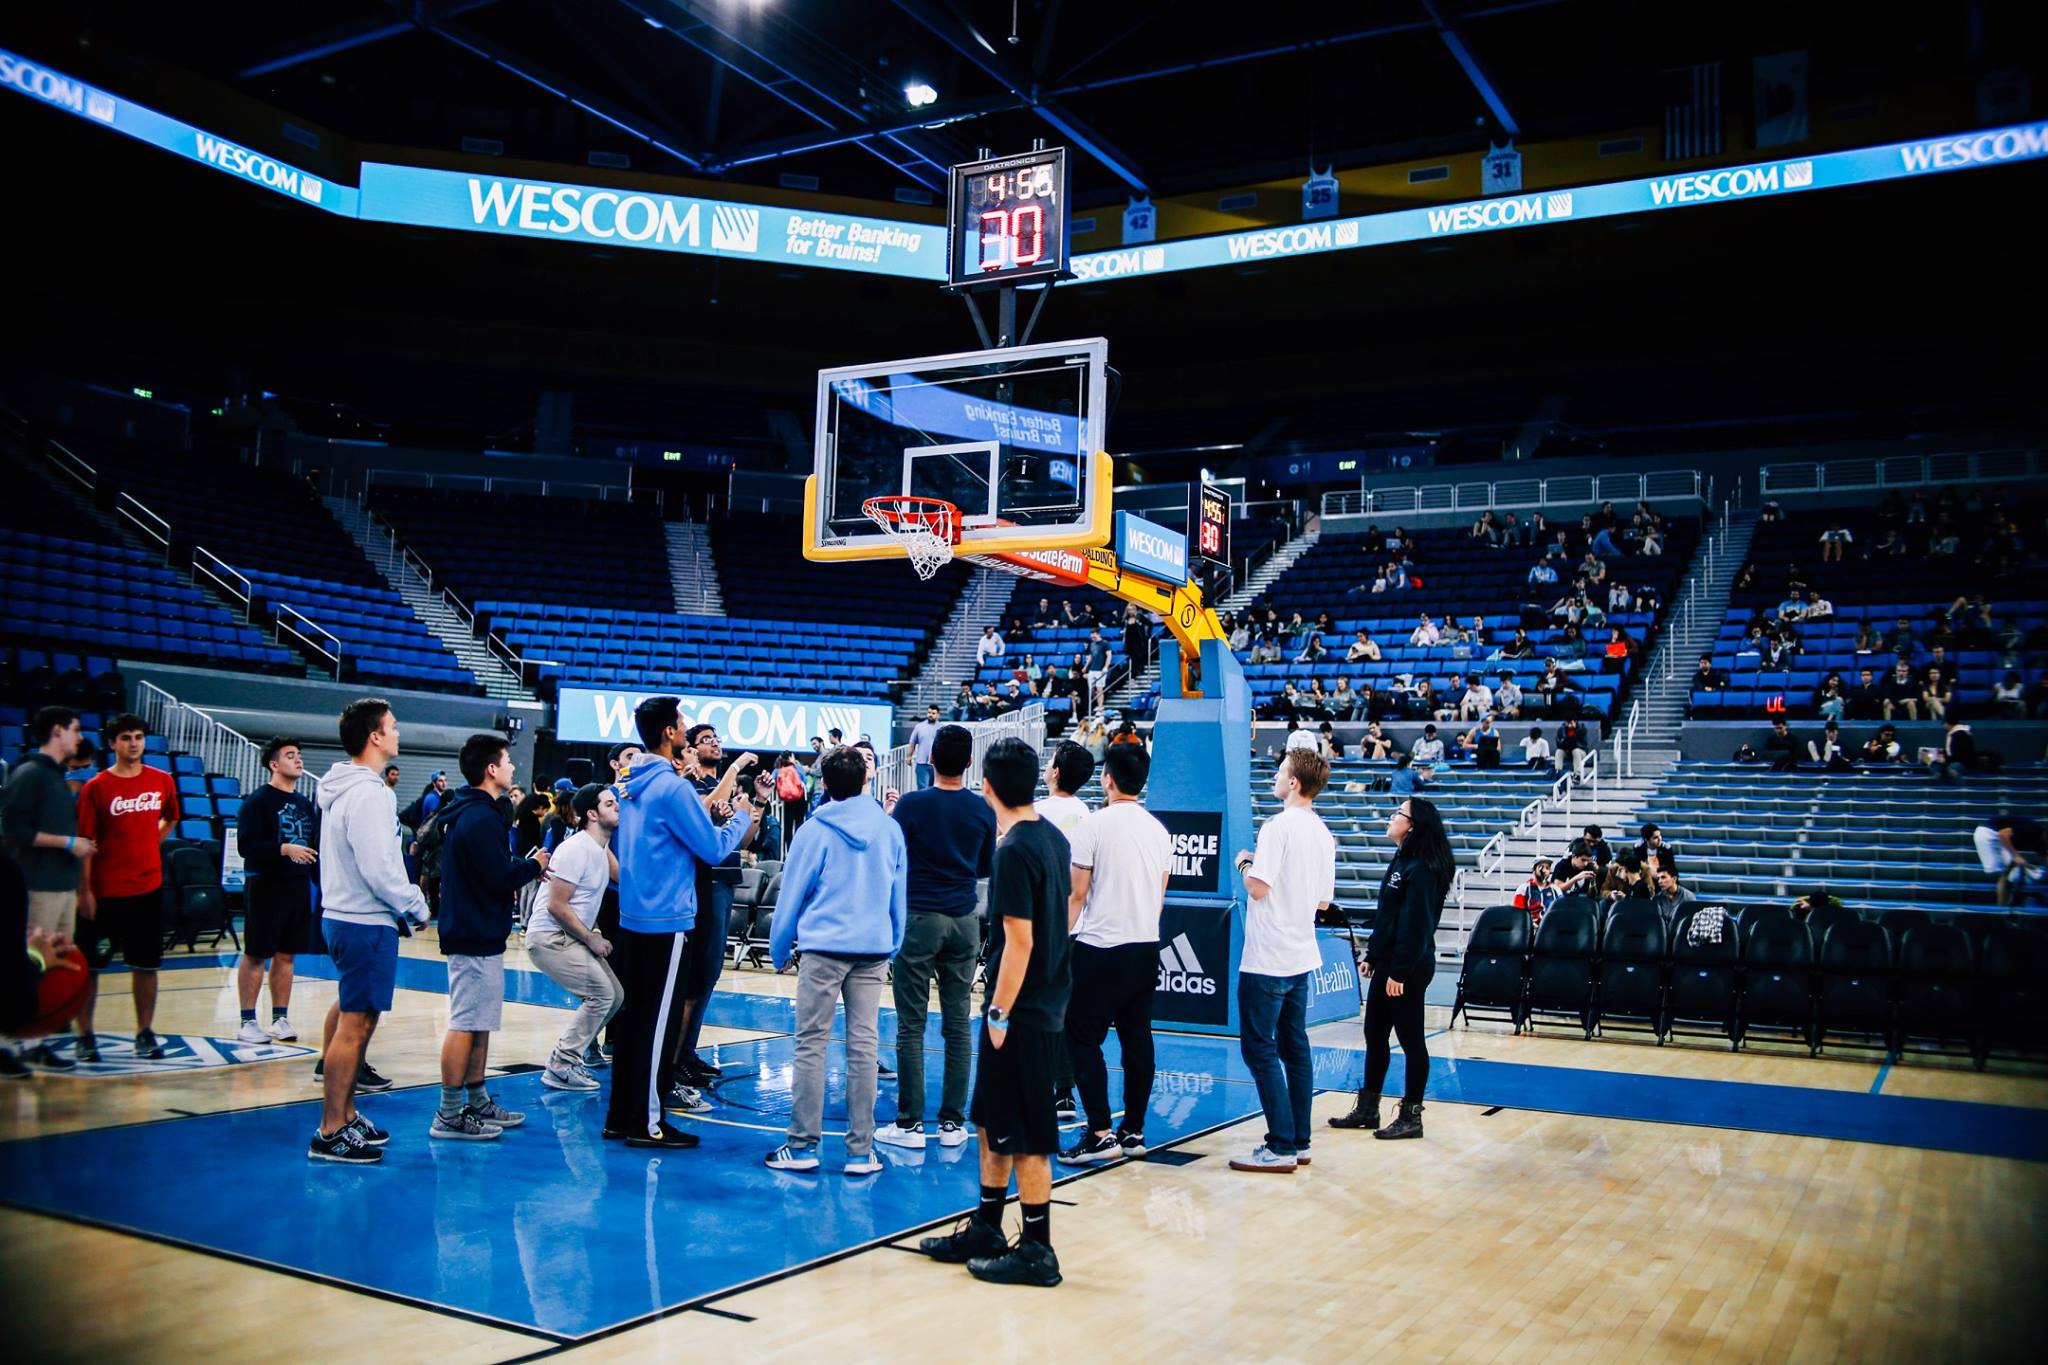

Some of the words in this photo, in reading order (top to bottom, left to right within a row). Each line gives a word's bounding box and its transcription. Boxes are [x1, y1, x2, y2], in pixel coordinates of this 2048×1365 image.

[196, 132, 298, 195] WESCOM
[983, 156, 1036, 171] DAKTRONICS
[1901, 127, 2048, 172] WESCOM
[1491, 162, 1512, 179] 31
[1650, 166, 1779, 205] WESCOM
[468, 178, 700, 247] WESCOM
[1428, 197, 1543, 233] WESCOM
[786, 215, 845, 240] Better
[848, 222, 921, 253] Banking
[786, 234, 814, 255] for
[816, 238, 882, 263] Bruins!
[980, 205, 1044, 271] 30
[1227, 224, 1332, 259] WESCOM
[821, 538, 848, 548] SPALDING
[1128, 527, 1174, 563] WESCOM
[1202, 521, 1219, 553] 30
[594, 694, 806, 747] WSCOM
[1313, 961, 1354, 995] Health
